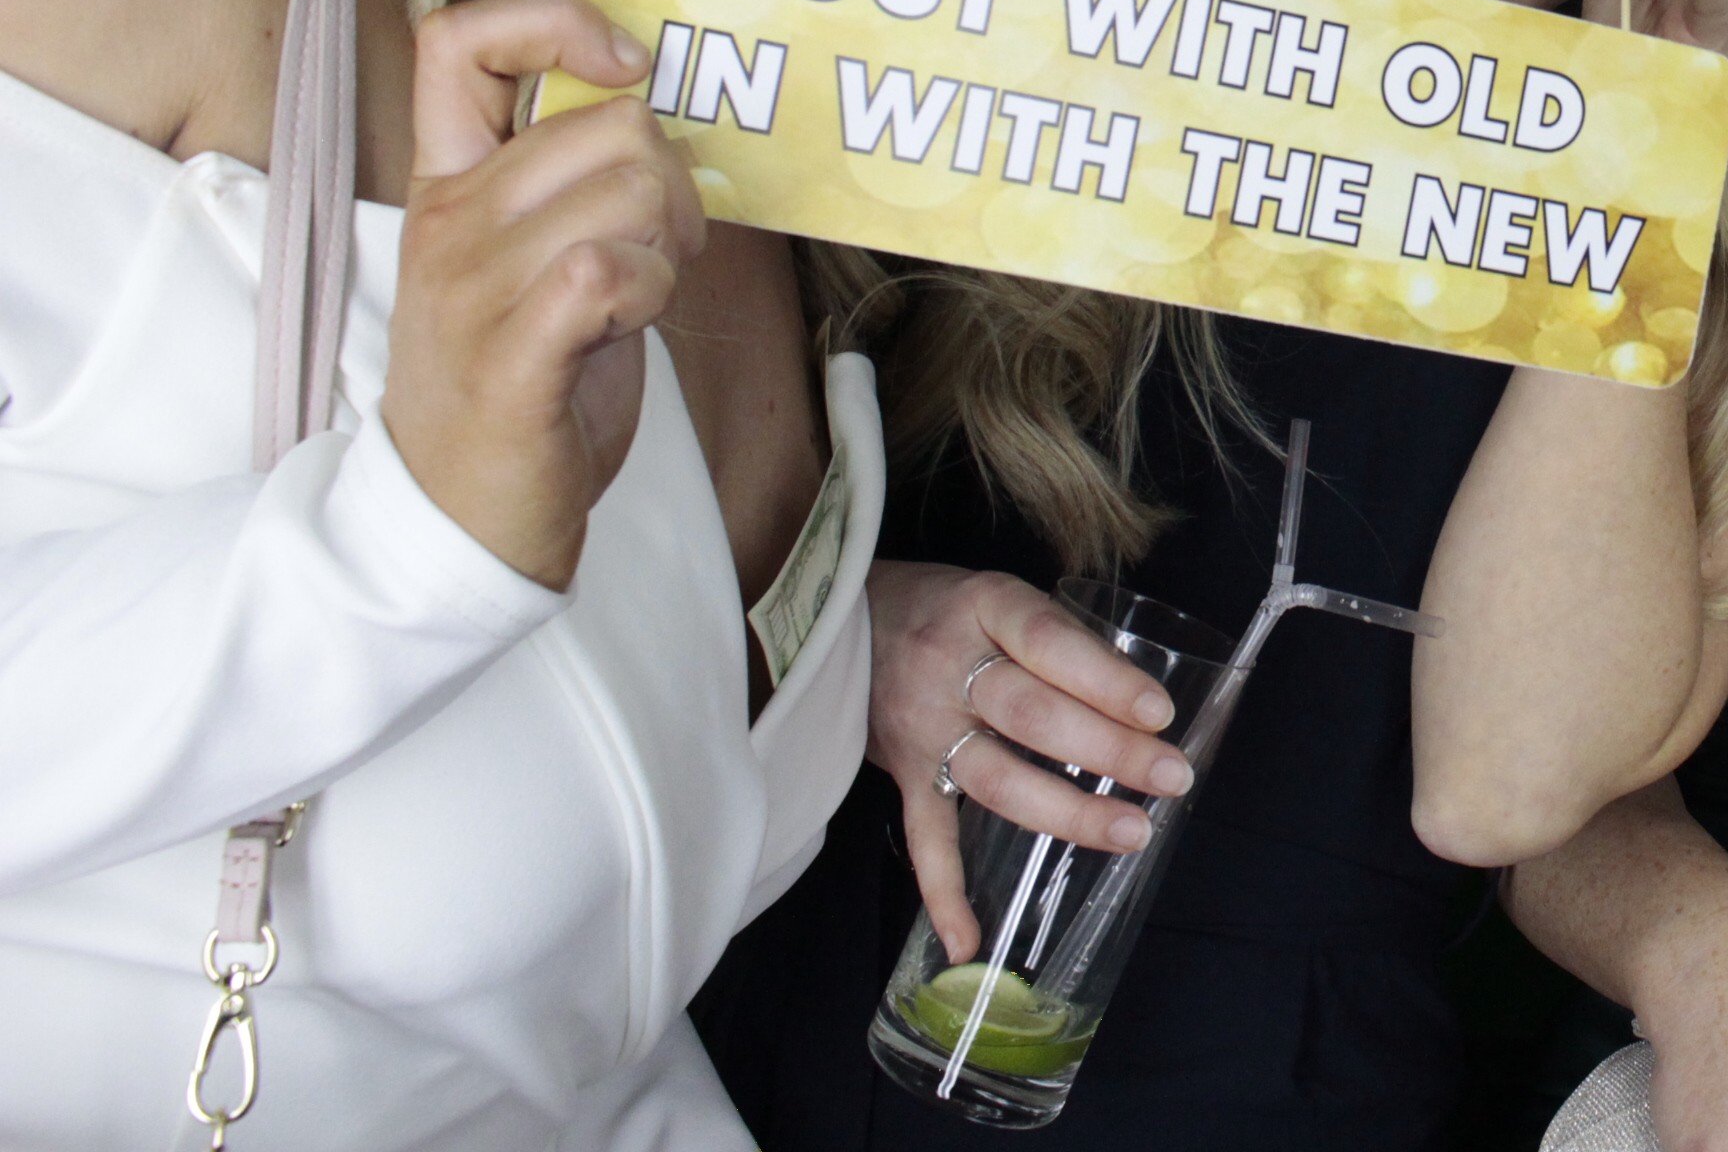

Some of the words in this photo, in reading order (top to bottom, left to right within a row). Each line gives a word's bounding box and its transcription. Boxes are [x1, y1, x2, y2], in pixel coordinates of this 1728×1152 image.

[648, 19, 786, 135] IN
[836, 56, 1141, 203] WITH
[1180, 127, 1373, 247] THE
[1401, 175, 1646, 296] NEW
[1381, 41, 1586, 153] OLD
